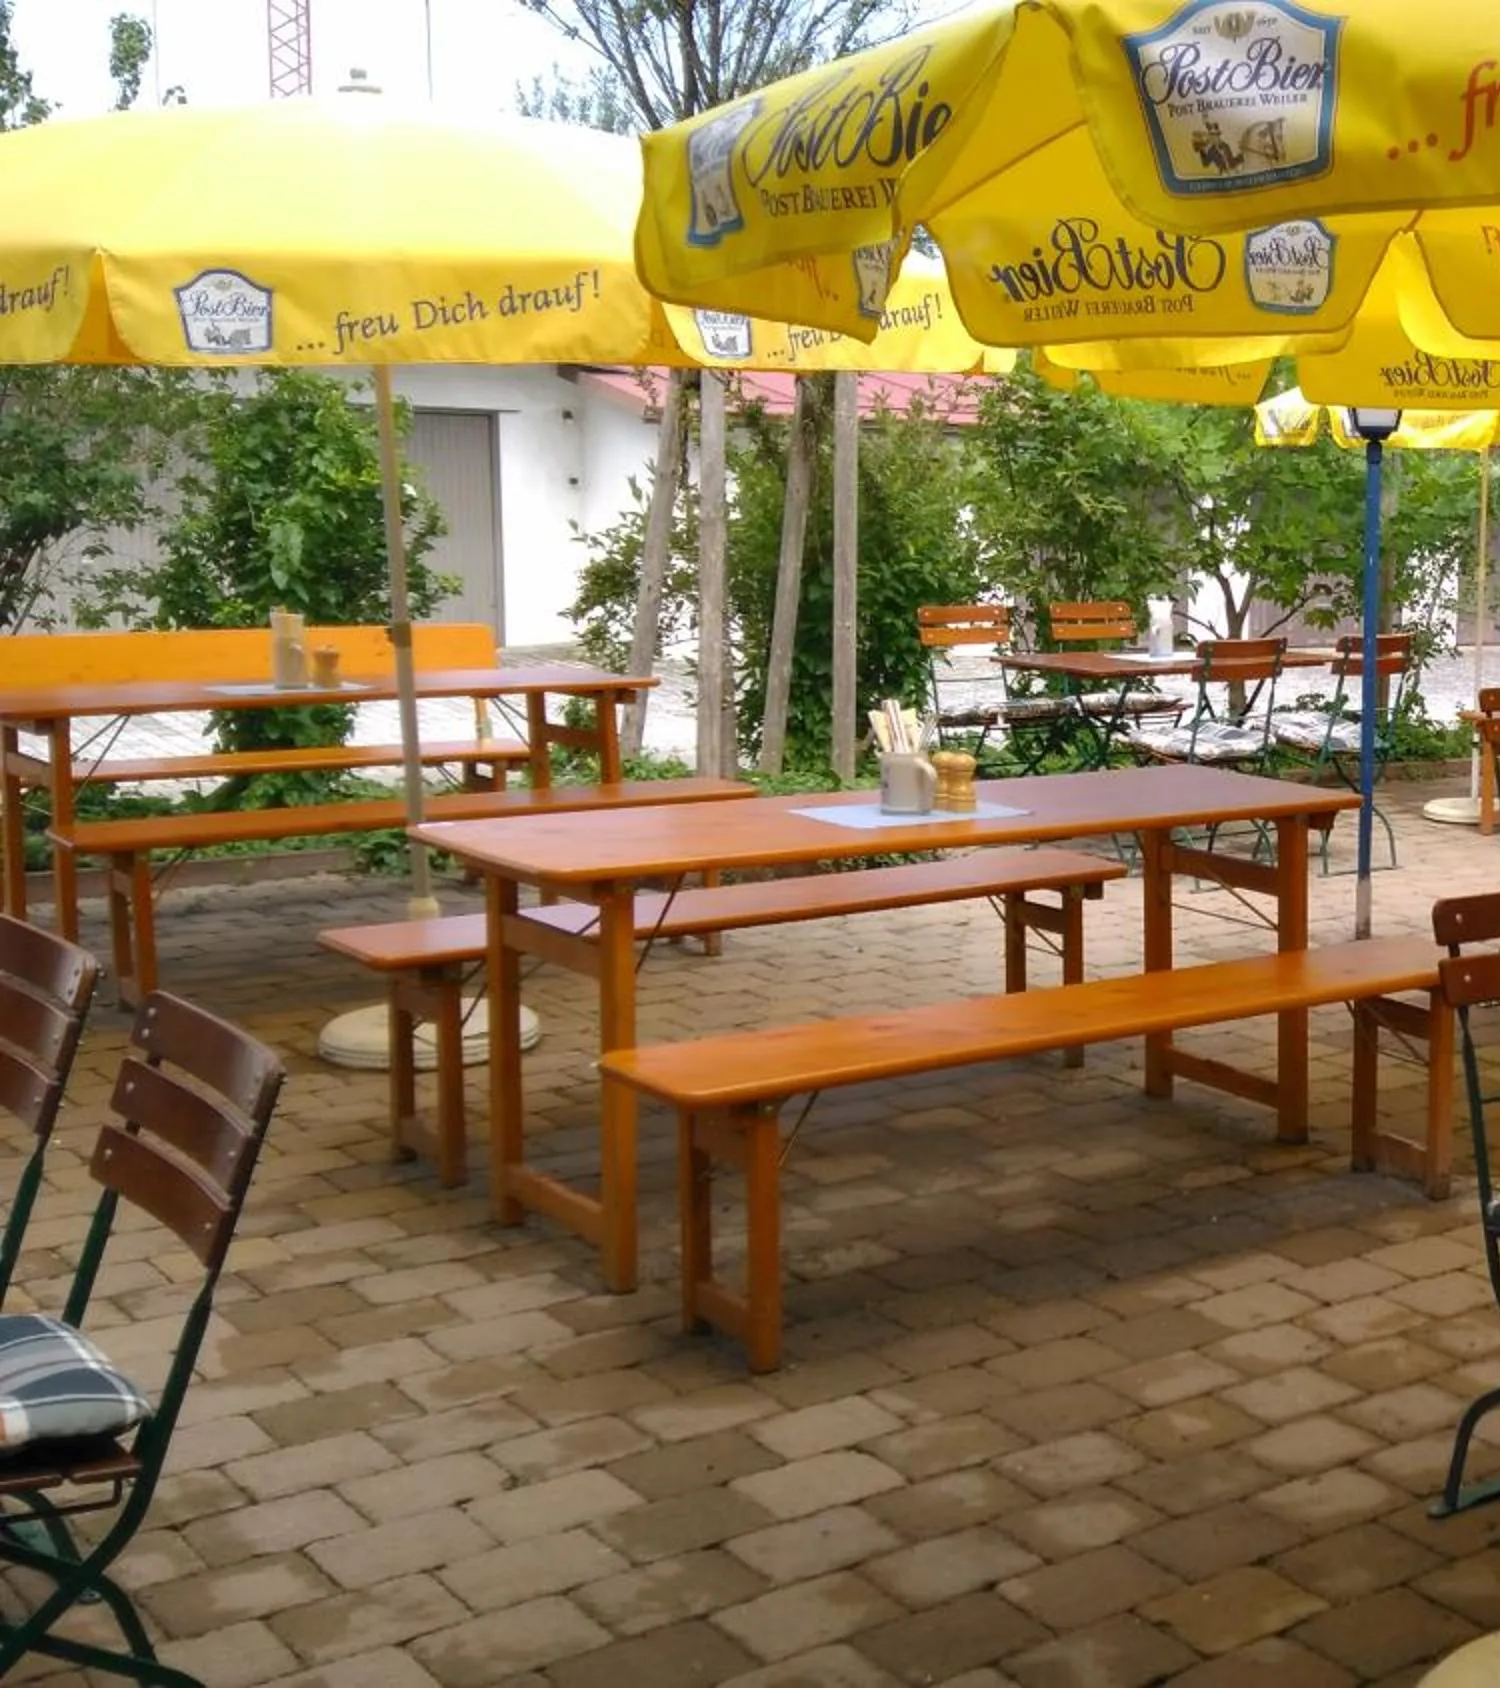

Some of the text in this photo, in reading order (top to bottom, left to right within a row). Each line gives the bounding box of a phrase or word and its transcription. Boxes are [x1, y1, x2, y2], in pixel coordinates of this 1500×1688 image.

[742, 44, 952, 188] PostBie
[412, 291, 490, 330] Dich
[498, 269, 601, 318] drauf!
